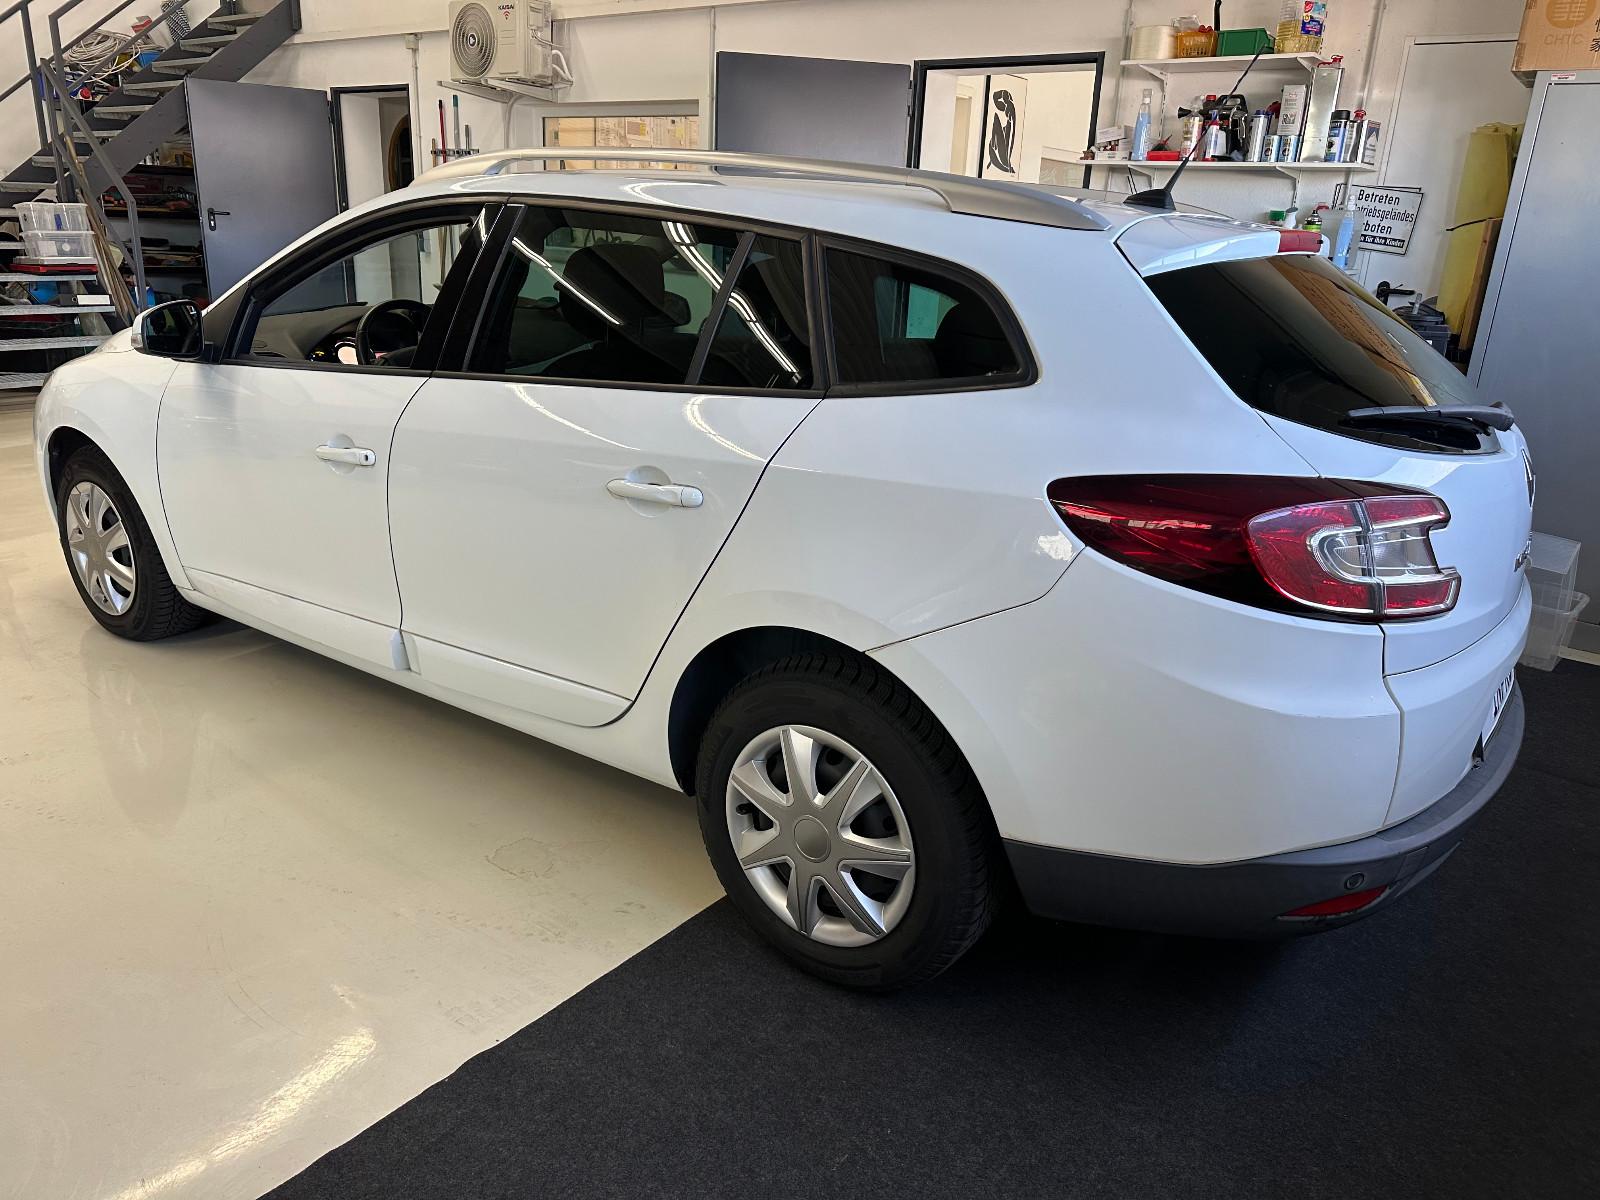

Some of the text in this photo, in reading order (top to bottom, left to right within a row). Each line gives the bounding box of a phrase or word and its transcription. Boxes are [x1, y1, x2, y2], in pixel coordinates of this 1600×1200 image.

[1358, 189, 1400, 206] Betreten
[1356, 204, 1414, 223] triebsgeländes
[1363, 220, 1392, 235] boten
[1365, 235, 1374, 243] für
[1385, 238, 1404, 248] Kinder
